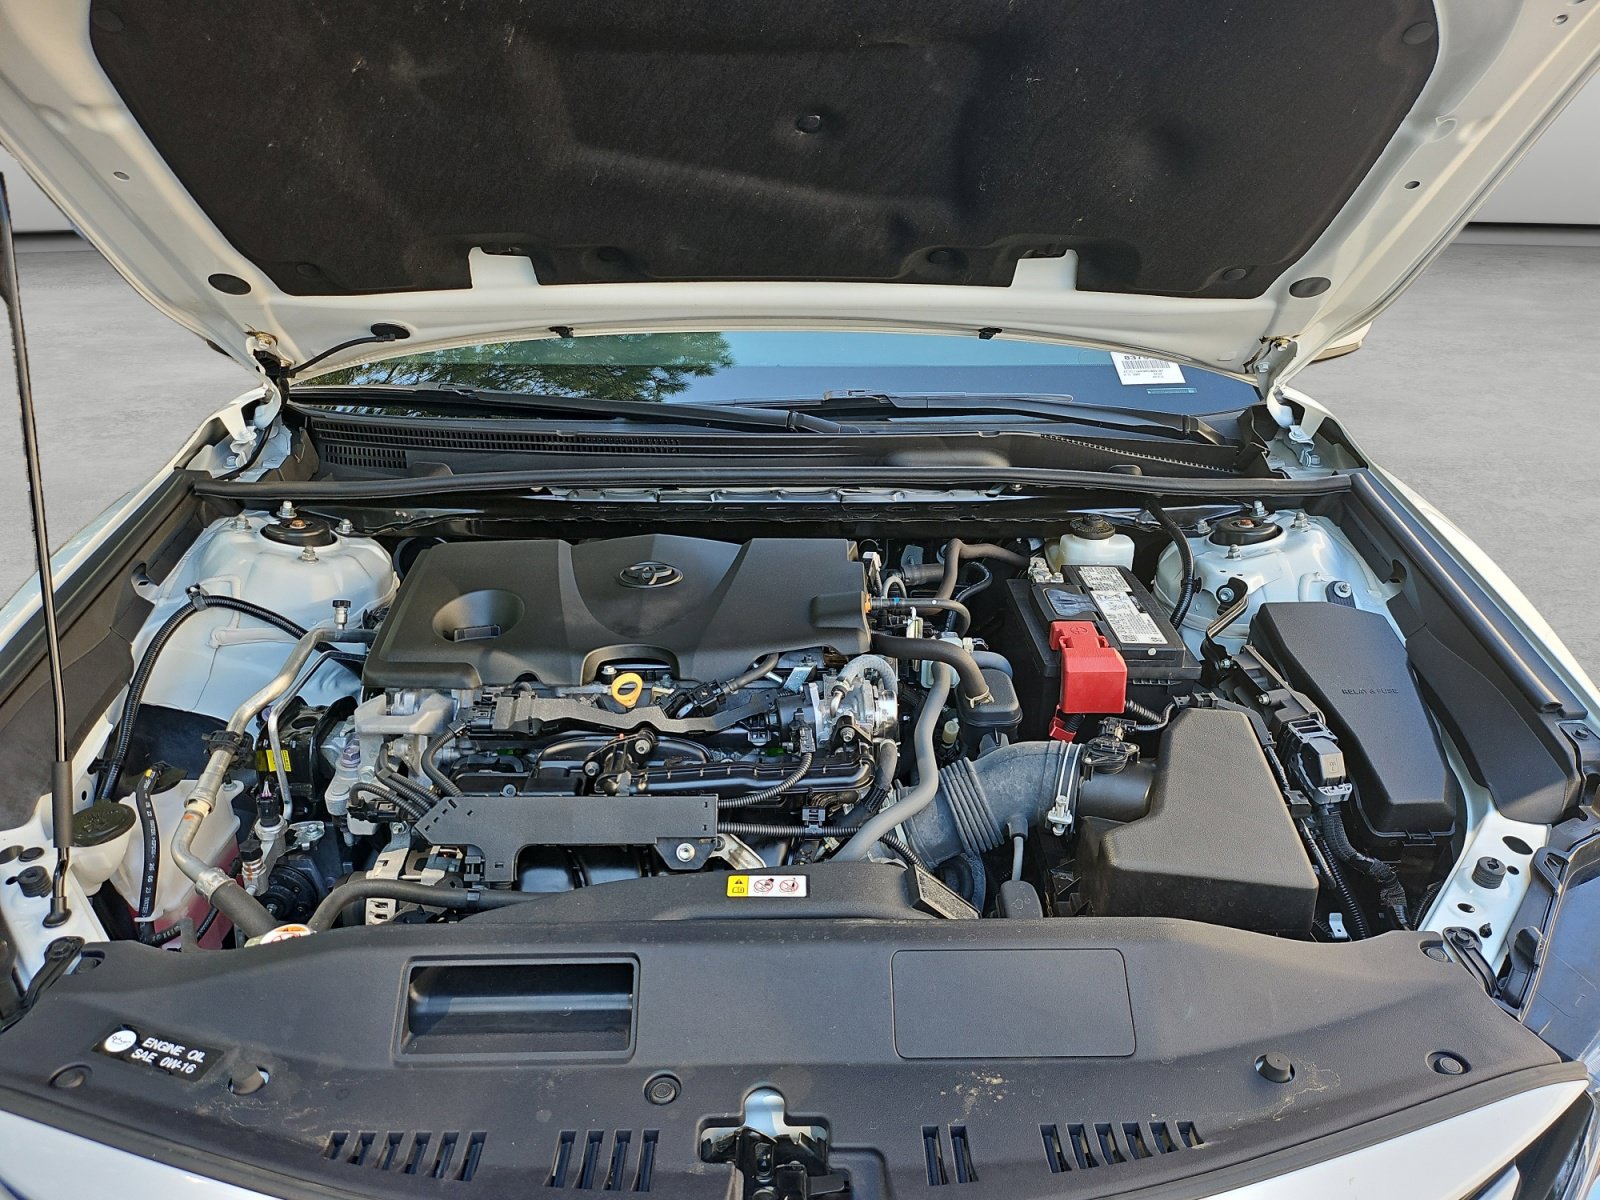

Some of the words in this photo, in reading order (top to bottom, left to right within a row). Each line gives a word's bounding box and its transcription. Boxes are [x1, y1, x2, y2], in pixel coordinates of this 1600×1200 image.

[142, 897, 150, 913] WATER
[131, 1048, 158, 1063] SAE
[159, 1057, 197, 1074] 0W-16
[142, 1037, 185, 1056] ENGINE
[187, 1050, 206, 1063] OIL
